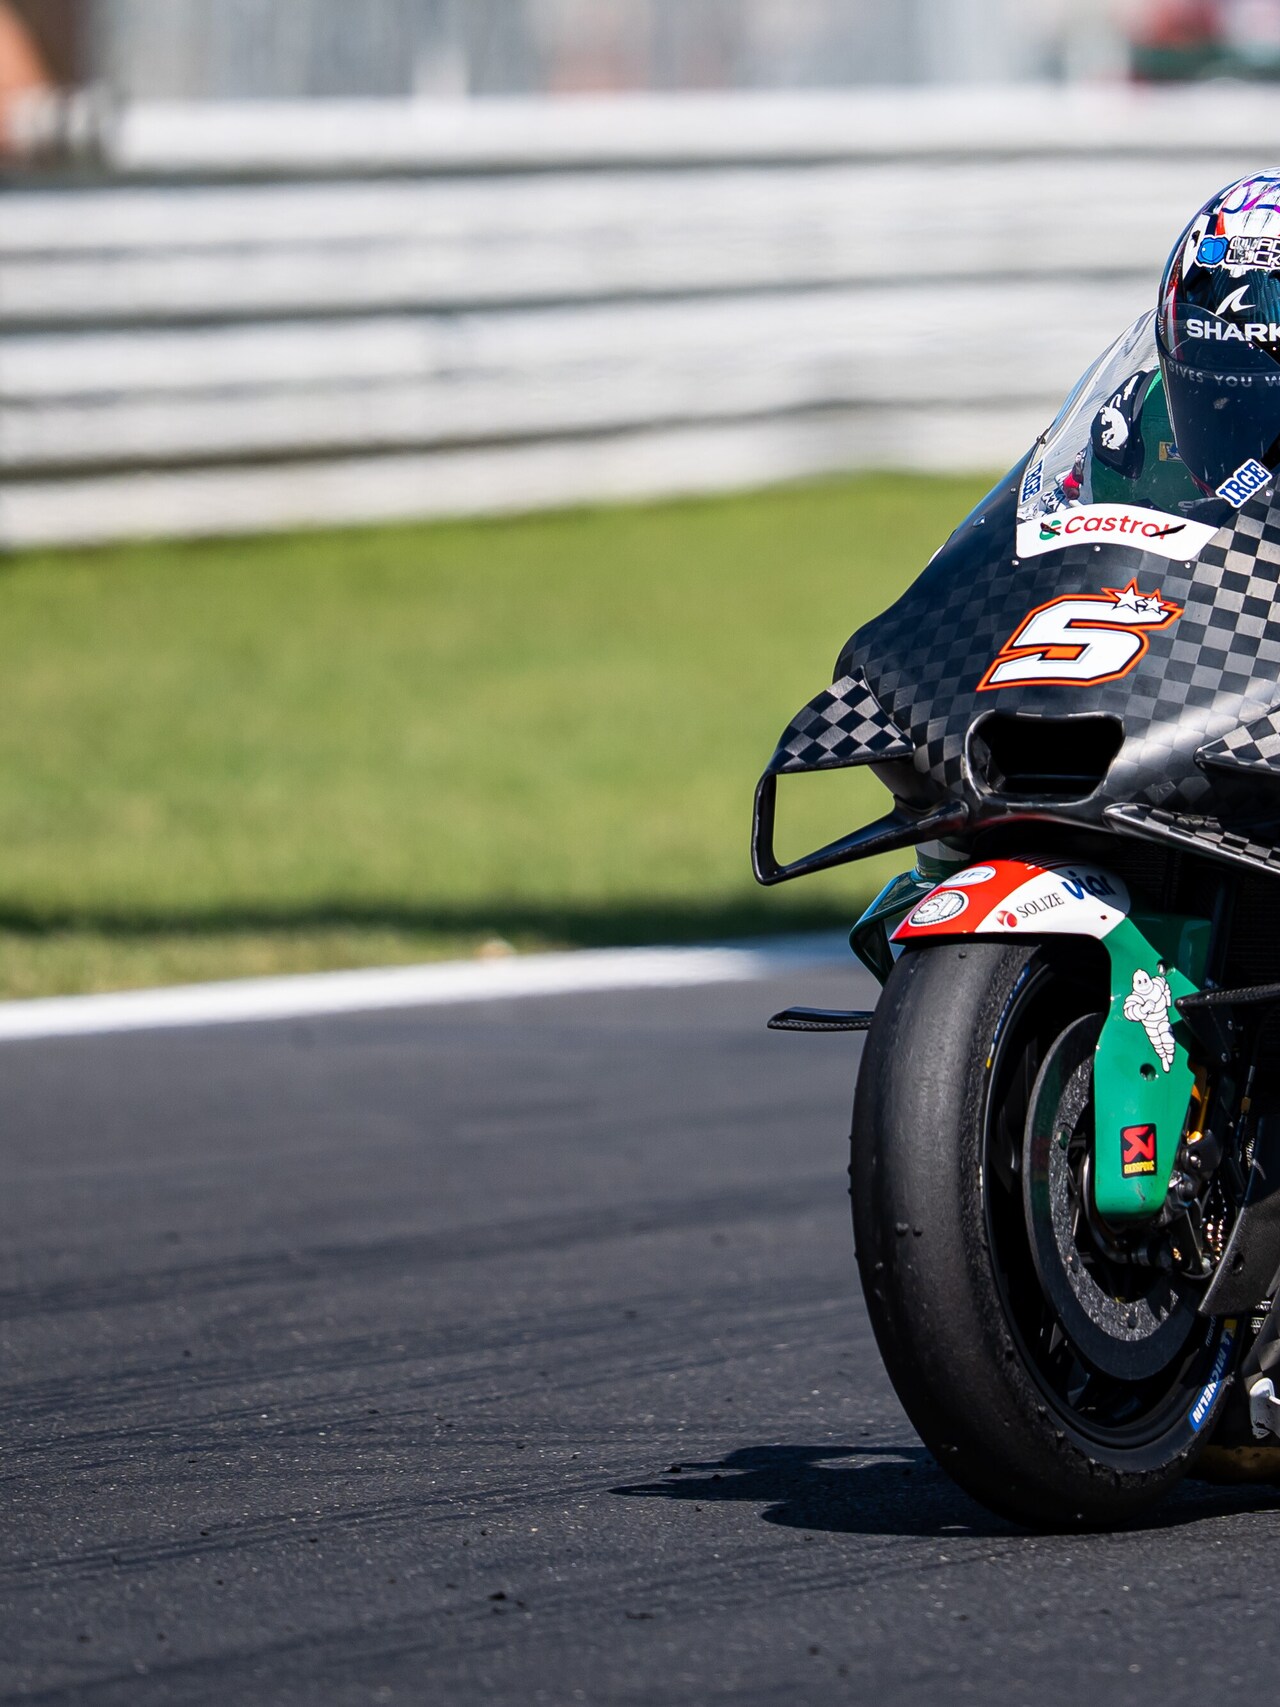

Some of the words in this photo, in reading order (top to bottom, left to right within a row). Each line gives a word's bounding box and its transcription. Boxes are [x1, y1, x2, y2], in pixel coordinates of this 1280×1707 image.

[1167, 360, 1204, 383] GIVES
[1213, 374, 1253, 388] YOU
[1218, 461, 1271, 506] IRGE
[1064, 515, 1170, 540] Castrol
[977, 588, 1184, 691] 5
[1016, 892, 1065, 919] SOLIZE
[1191, 1345, 1228, 1423] MICHELIN
